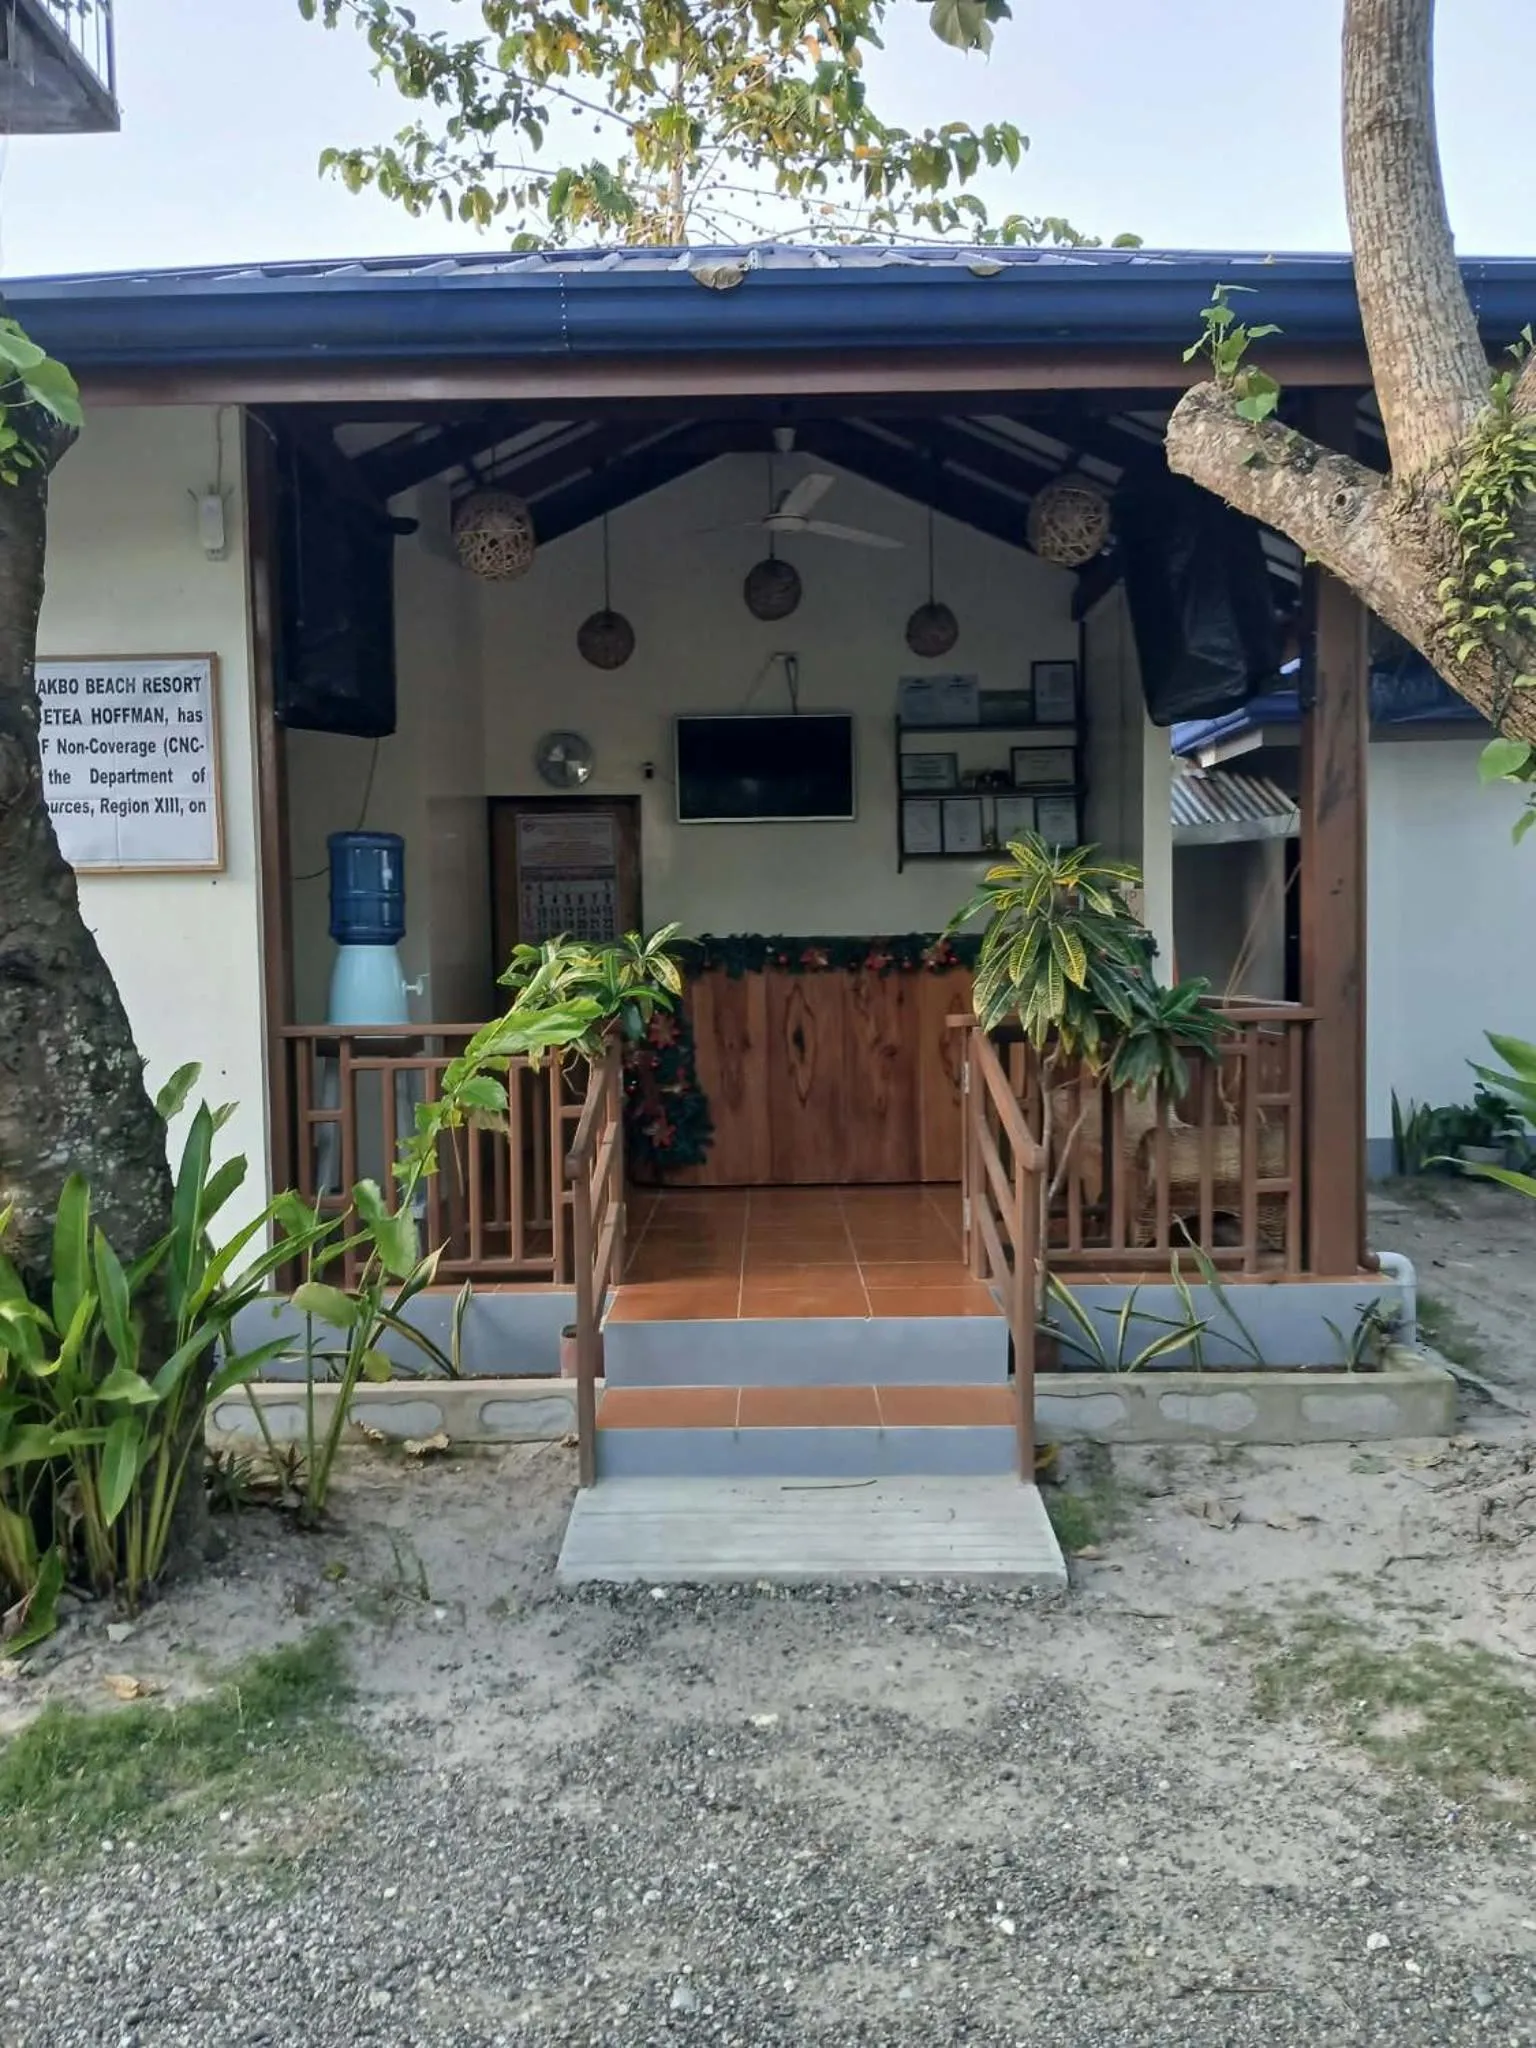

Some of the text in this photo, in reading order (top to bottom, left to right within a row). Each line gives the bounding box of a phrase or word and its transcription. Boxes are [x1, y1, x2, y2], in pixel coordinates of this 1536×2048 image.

[87, 677, 135, 693] BEACH
[143, 677, 201, 693] RESORT
[92, 708, 169, 726] HOFFMAN,
[178, 708, 202, 723] has
[57, 738, 156, 757] Non-Coverage
[164, 737, 204, 757] (CNC-
[49, 767, 206, 787] the Department of
[100, 799, 149, 817] Region
[155, 798, 184, 816] XIII,
[190, 801, 206, 813] on
